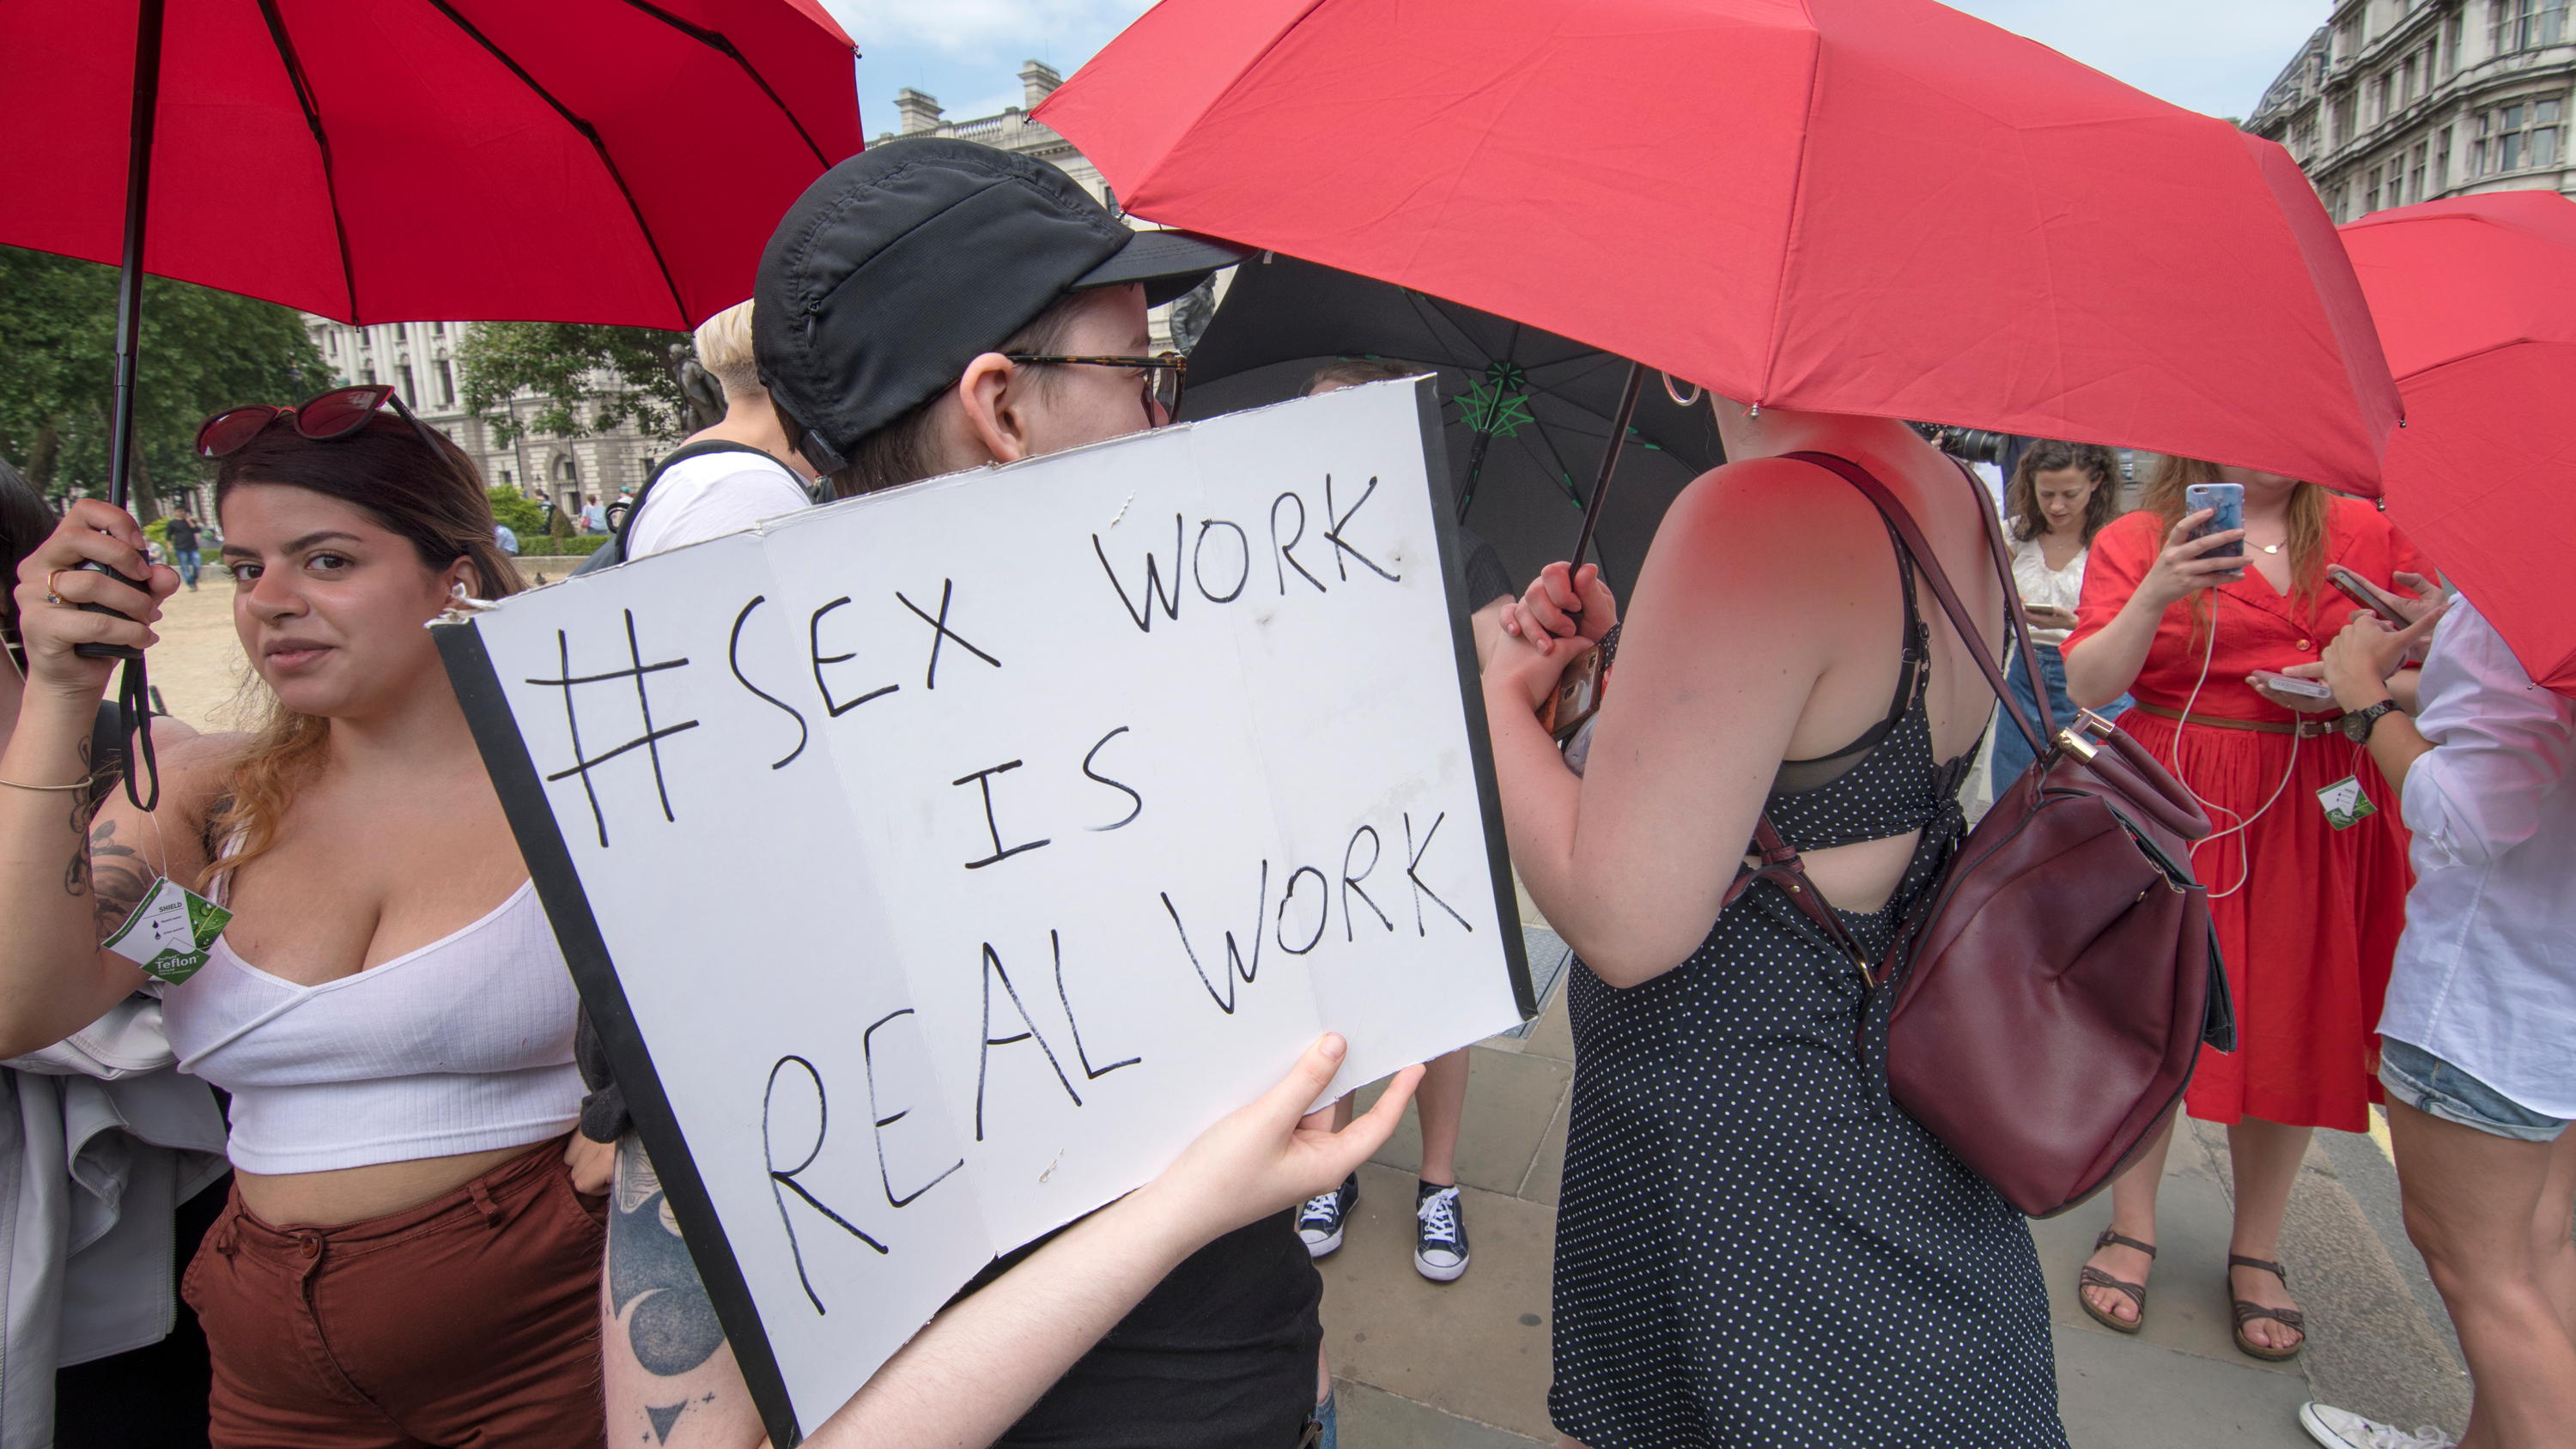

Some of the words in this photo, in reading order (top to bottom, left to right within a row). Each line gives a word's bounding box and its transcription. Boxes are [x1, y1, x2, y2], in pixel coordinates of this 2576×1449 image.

[525, 577, 1001, 848] #SEX
[1093, 474, 1400, 632] WORK
[953, 727, 1141, 869] IS
[155, 955, 197, 969] Teflon
[159, 902, 182, 912] SHIELD
[762, 929, 1142, 1316] REAL
[1161, 812, 1472, 1014] WORK
